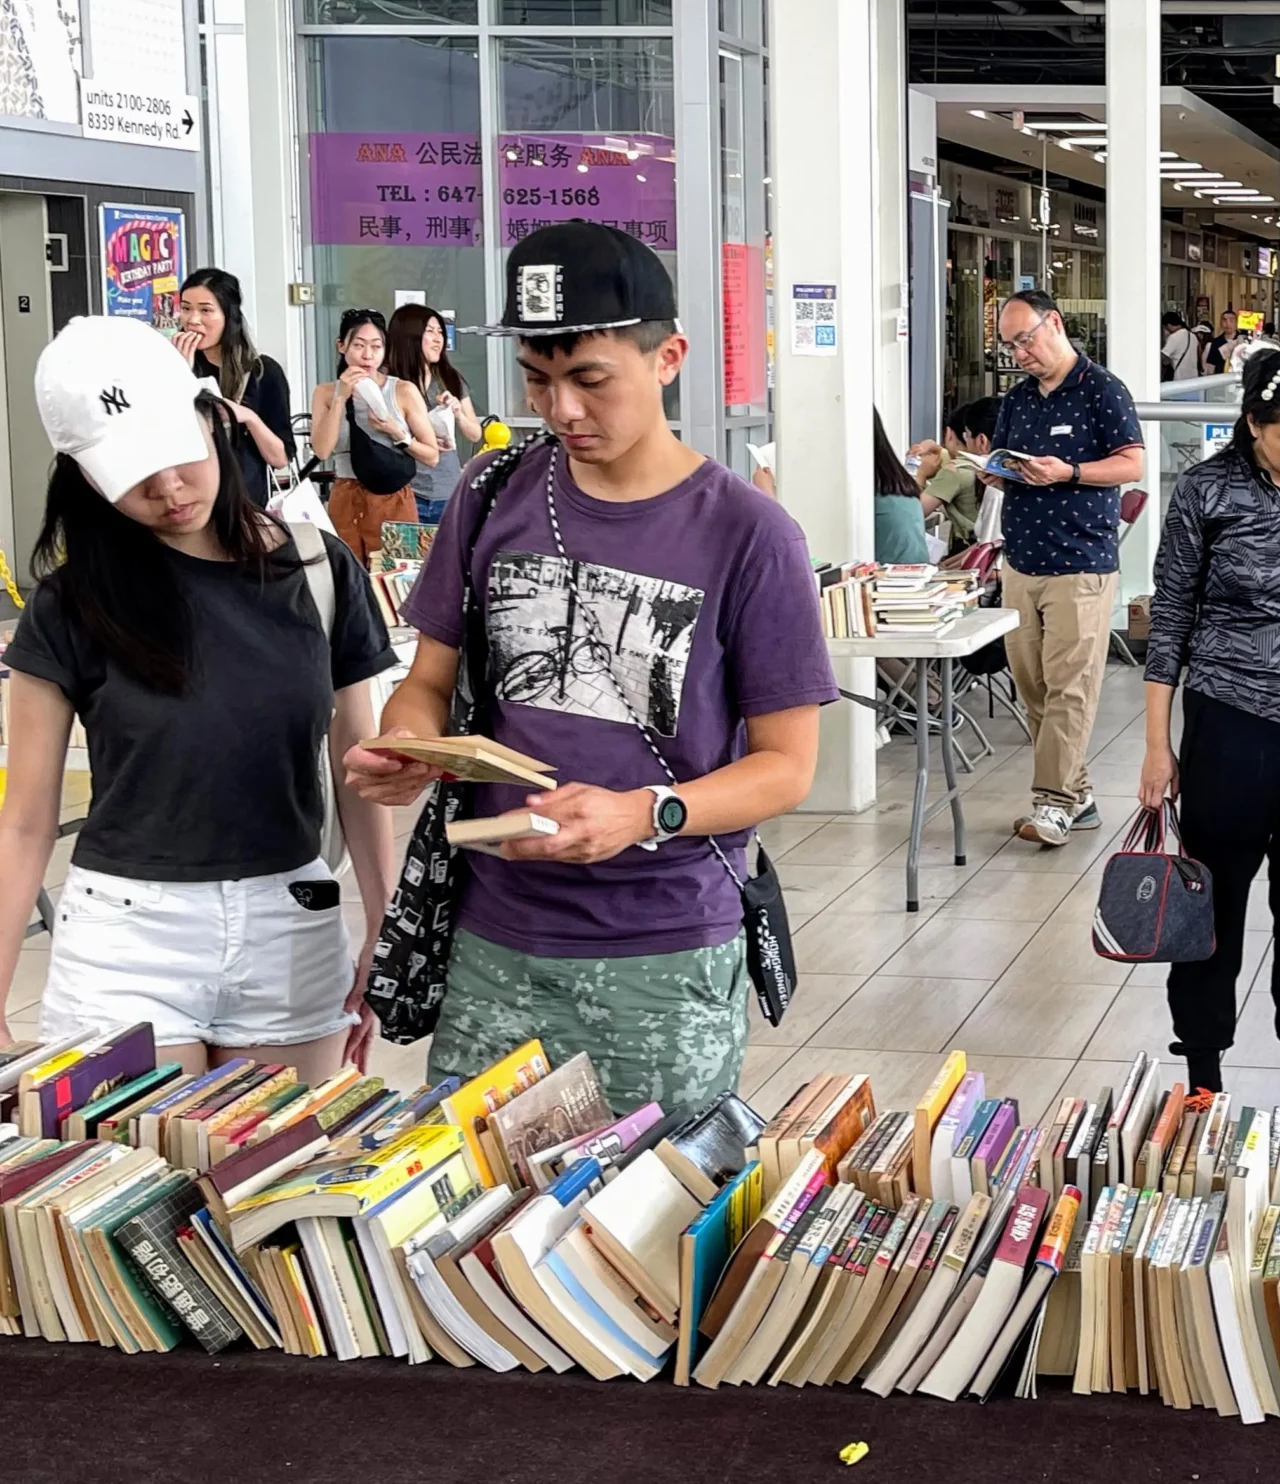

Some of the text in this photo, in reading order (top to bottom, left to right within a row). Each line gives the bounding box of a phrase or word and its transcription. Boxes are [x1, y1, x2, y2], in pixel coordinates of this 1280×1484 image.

[86, 90, 171, 116] units 2100-2806
[88, 112, 181, 141] 8339 Kennedy Rd.
[356, 143, 407, 163] ANA
[377, 185, 416, 202] TEL
[115, 232, 169, 262] MAGIC
[152, 260, 173, 276] PARTY
[20, 297, 28, 308] 2
